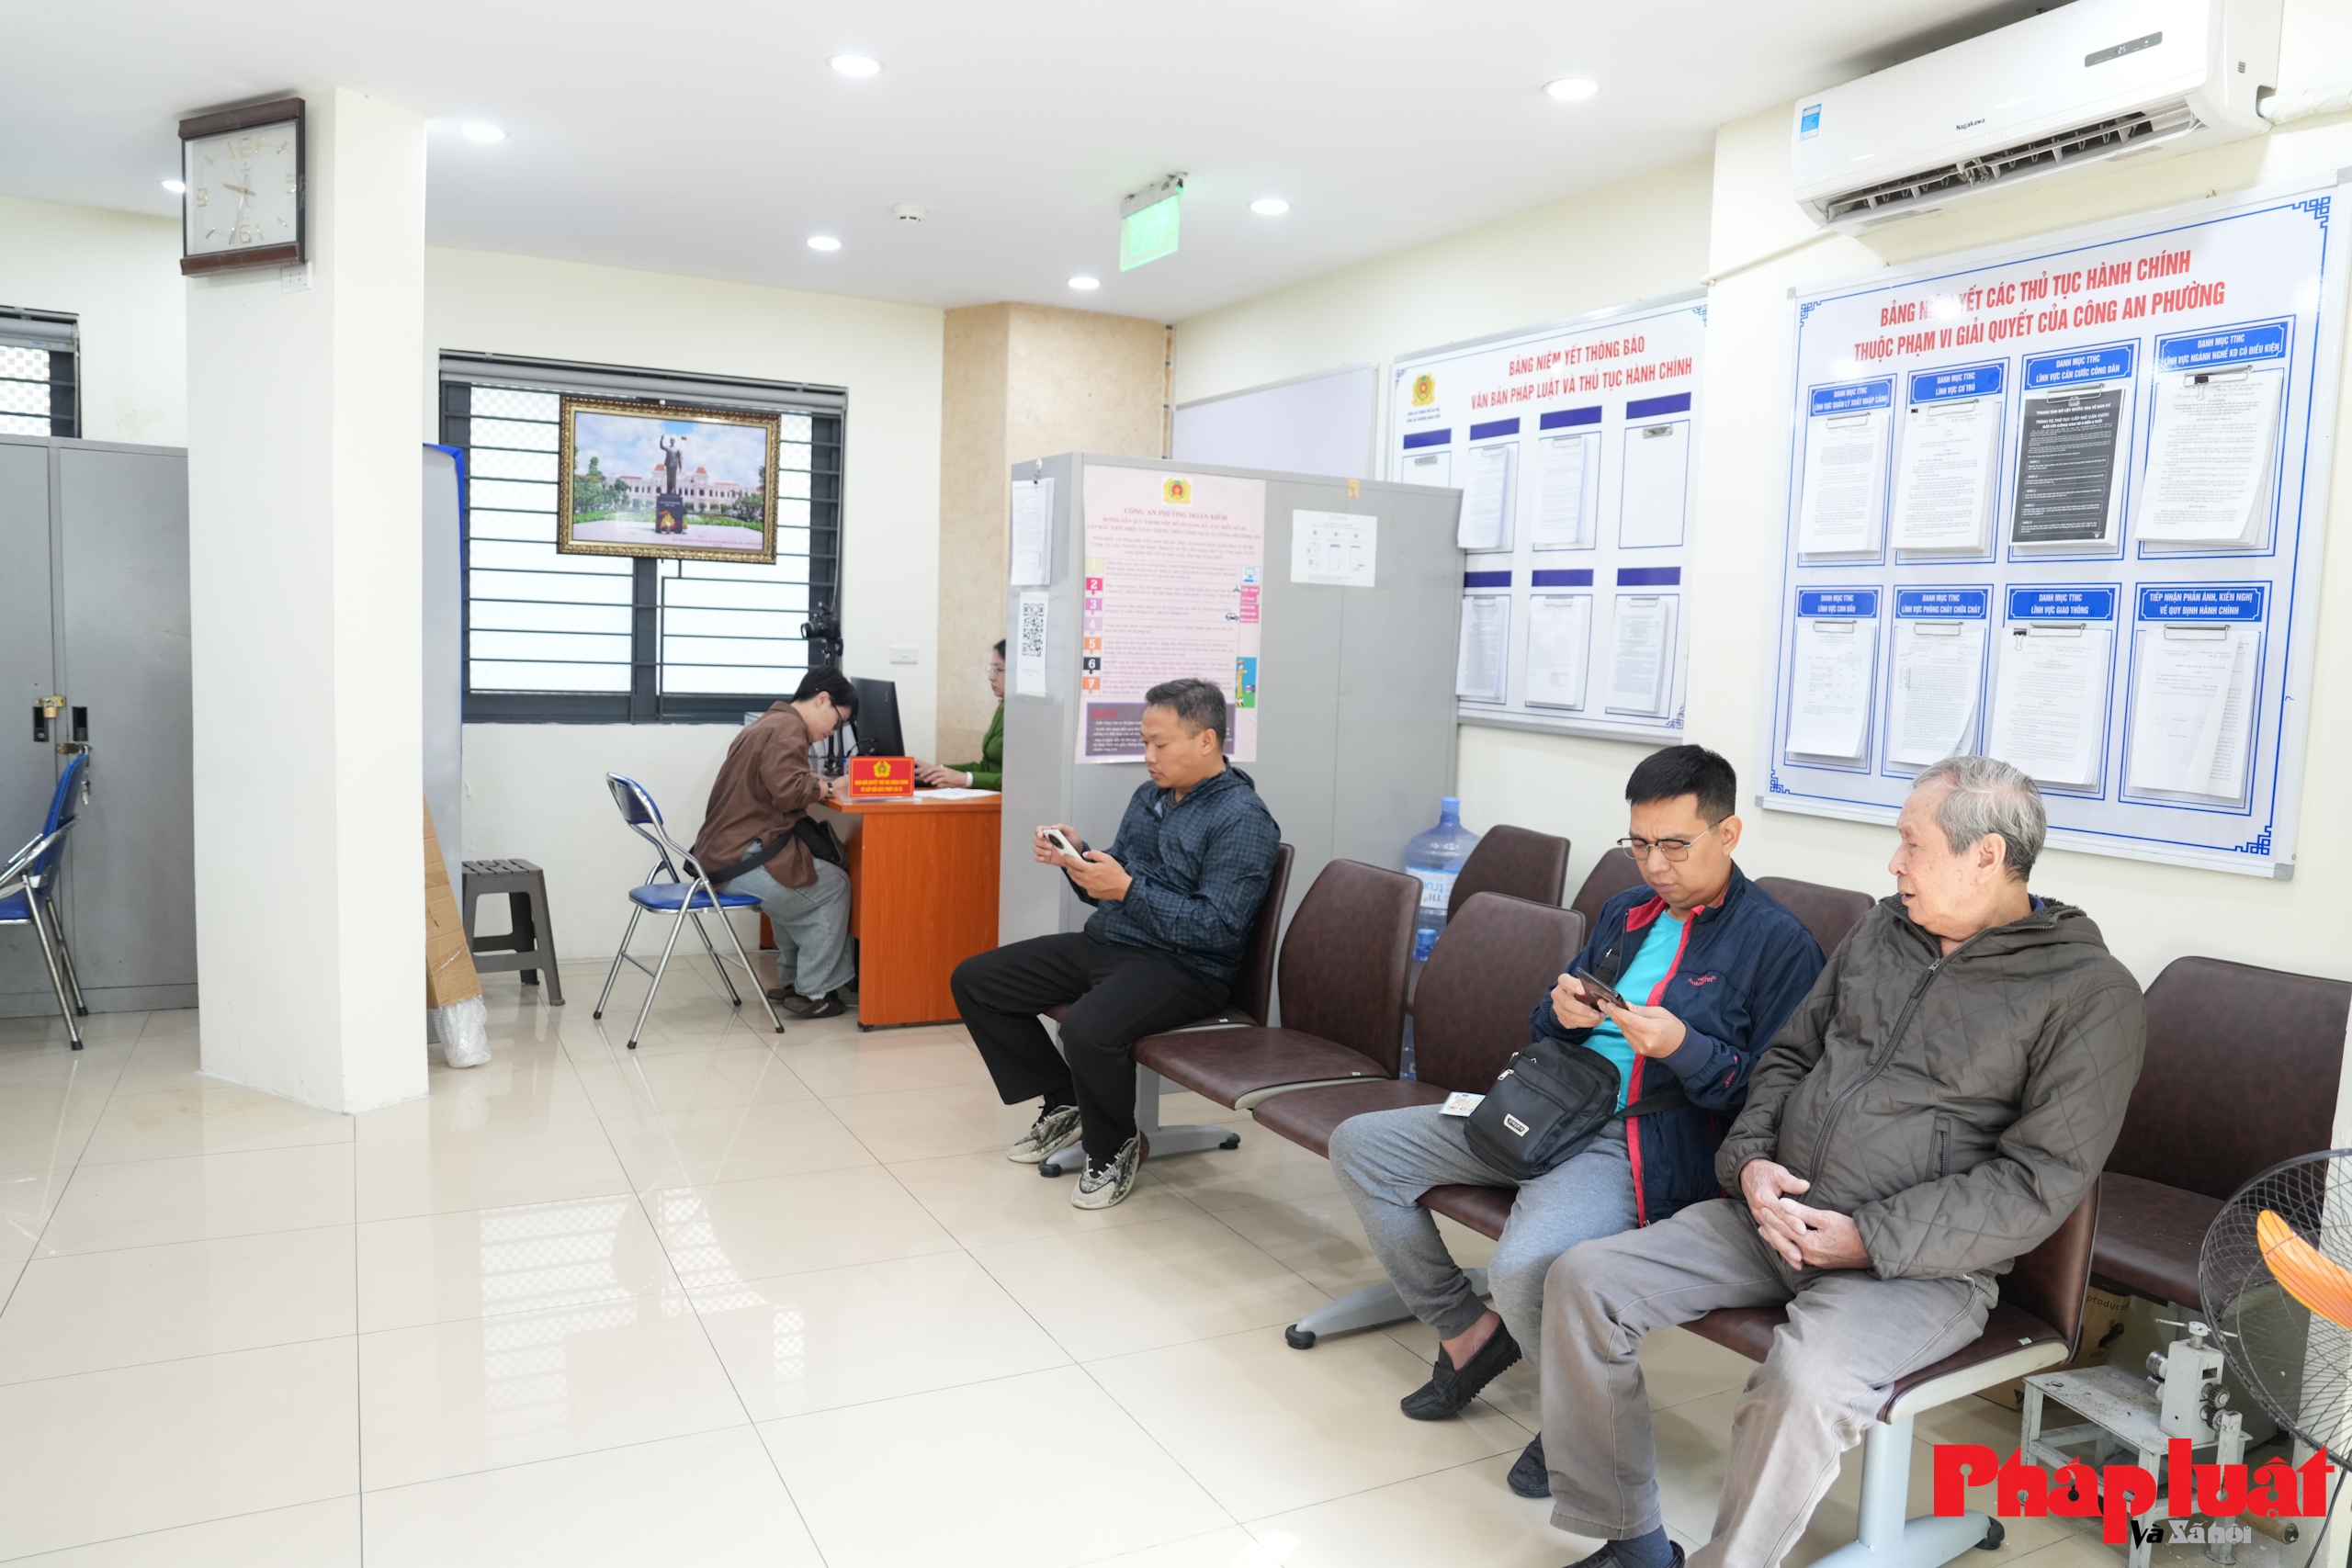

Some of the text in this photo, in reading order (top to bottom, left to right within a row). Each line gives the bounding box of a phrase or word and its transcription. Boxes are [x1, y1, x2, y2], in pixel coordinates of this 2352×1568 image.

[1956, 118, 1984, 130] Nagakawa
[1130, 215, 1169, 257] EXIT
[1881, 299, 1916, 327] BẢNG
[1986, 281, 2016, 309] CÁC
[2019, 269, 2049, 302] THỦ
[2052, 271, 2082, 299] TỤC
[2086, 262, 2132, 290] HÀNH
[2137, 250, 2191, 281] CHÍNH
[1854, 281, 2225, 362] THUỘC PHẠM VI GIẢI QUYẾT CỦA CÔNG AN PHƯỜNG
[2198, 334, 2245, 349] DANH MỤC TTHC
[1510, 355, 1533, 376] BẢNG
[1565, 342, 1582, 366] YẾT
[1586, 340, 1620, 363] THÔNG
[1623, 333, 1645, 355] BÁO
[2178, 355, 2189, 365] VỰC
[2190, 351, 2211, 363] NGÀNH
[2230, 349, 2238, 357] KD
[2239, 346, 2247, 356] CÓ
[2265, 343, 2280, 354] KIỆN
[2056, 355, 2100, 367] DANH MỤC TTHC
[1937, 372, 1975, 384] DANH MỤC TTHC
[2036, 373, 2049, 382] LĨNH
[2050, 372, 2060, 382] VỰC
[2062, 369, 2073, 380] CĂN
[2091, 366, 2106, 376] CÔNG
[2108, 364, 2120, 373] DÂN
[1471, 355, 1692, 410] VĂN BẢN PHÁP LUẬT VÀ THỦ TỤC HÀNH CHÍNH
[1834, 387, 1867, 399] DANH MỤC TTHC
[1935, 384, 1975, 396] LĨNH VỰC CƯ TRÚ
[1091, 580, 1098, 590] 2
[1821, 594, 1832, 603] DANH
[1832, 594, 1843, 603] MỤC
[1922, 594, 1960, 603] DANH MỤC TTHC
[2039, 593, 2053, 602] DANH
[2054, 593, 2067, 603] MỤC
[2150, 590, 2253, 604] TIẾP NHẬN PHẢN ÁNH, KIẾN NGHỊ
[1090, 599, 1097, 609] 3
[2030, 605, 2043, 614] LĨNH
[2045, 605, 2055, 615] VỰC
[2071, 605, 2089, 614] THÔNG
[2168, 606, 2181, 615] QUY
[2182, 606, 2198, 616] ĐỊNH
[2199, 605, 2217, 615] HÀNH
[2218, 604, 2239, 615] CHÍNH
[1089, 619, 1095, 629] 4
[1089, 639, 1095, 649] 5
[1088, 659, 1095, 669] 6
[1088, 679, 1095, 689] 7
